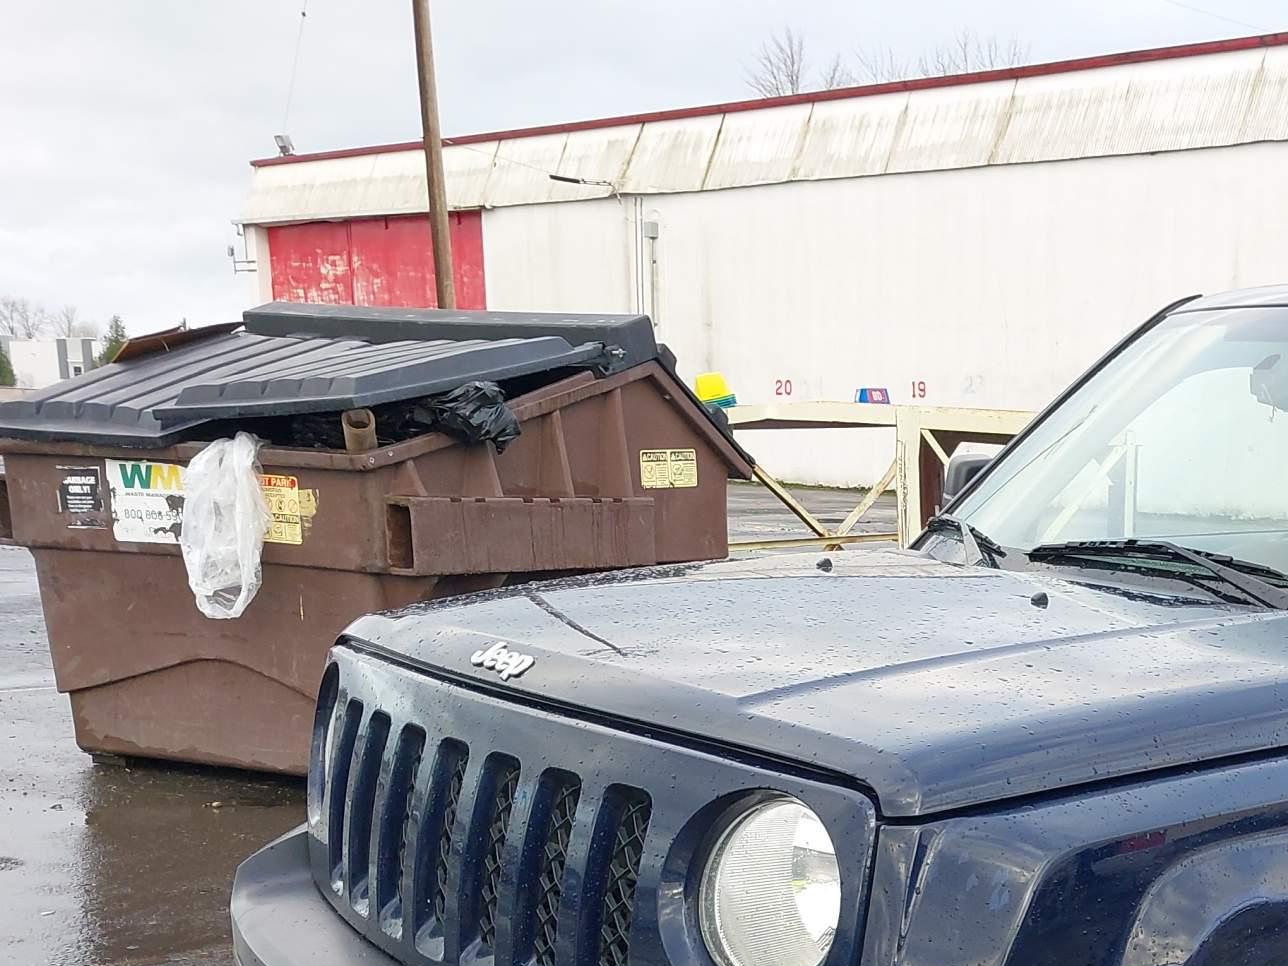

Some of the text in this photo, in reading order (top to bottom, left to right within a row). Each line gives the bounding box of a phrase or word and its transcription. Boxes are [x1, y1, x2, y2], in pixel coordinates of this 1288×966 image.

[775, 379, 793, 396] 20
[911, 381, 926, 398] 19
[118, 463, 183, 490] WM
[124, 509, 143, 520] 800
[470, 642, 535, 681] Jeep
